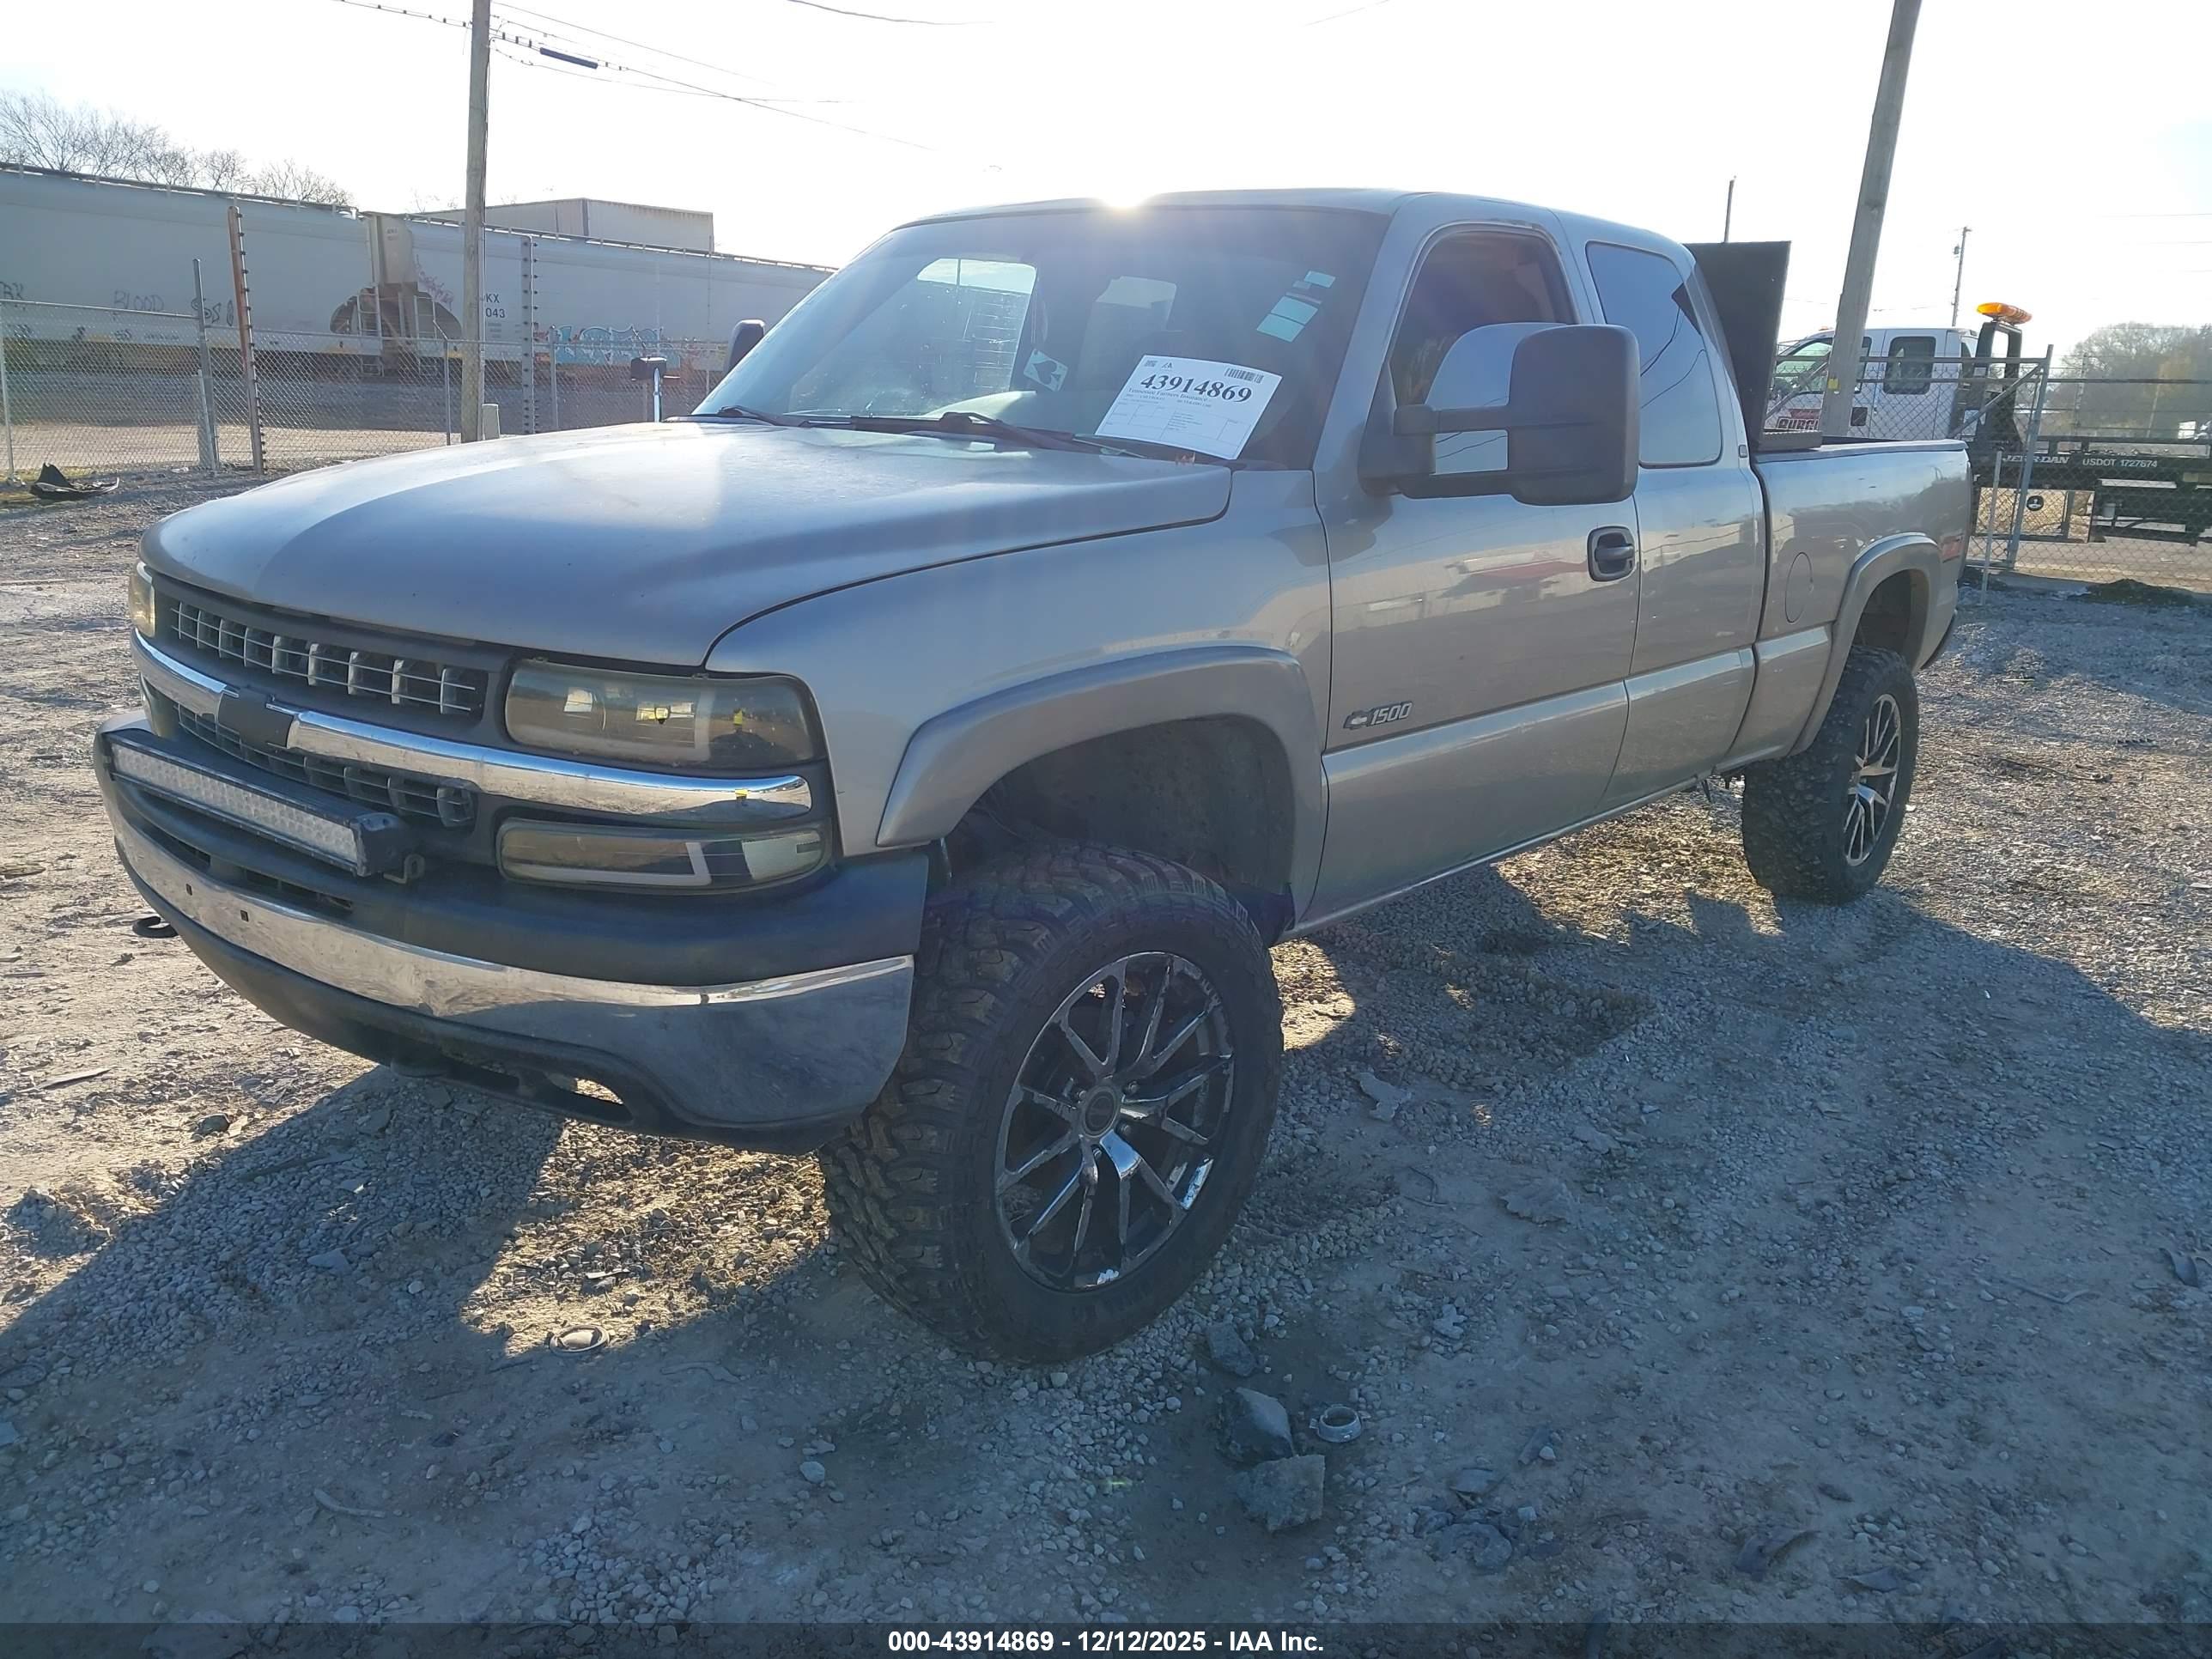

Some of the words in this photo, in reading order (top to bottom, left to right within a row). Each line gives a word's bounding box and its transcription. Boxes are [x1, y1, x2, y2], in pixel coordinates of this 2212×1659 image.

[483, 293, 500, 303] KX
[485, 307, 506, 318] 043
[1140, 374, 1252, 403] 43914869
[2082, 458, 2117, 467] USDOT
[1370, 702, 1413, 726] 1500
